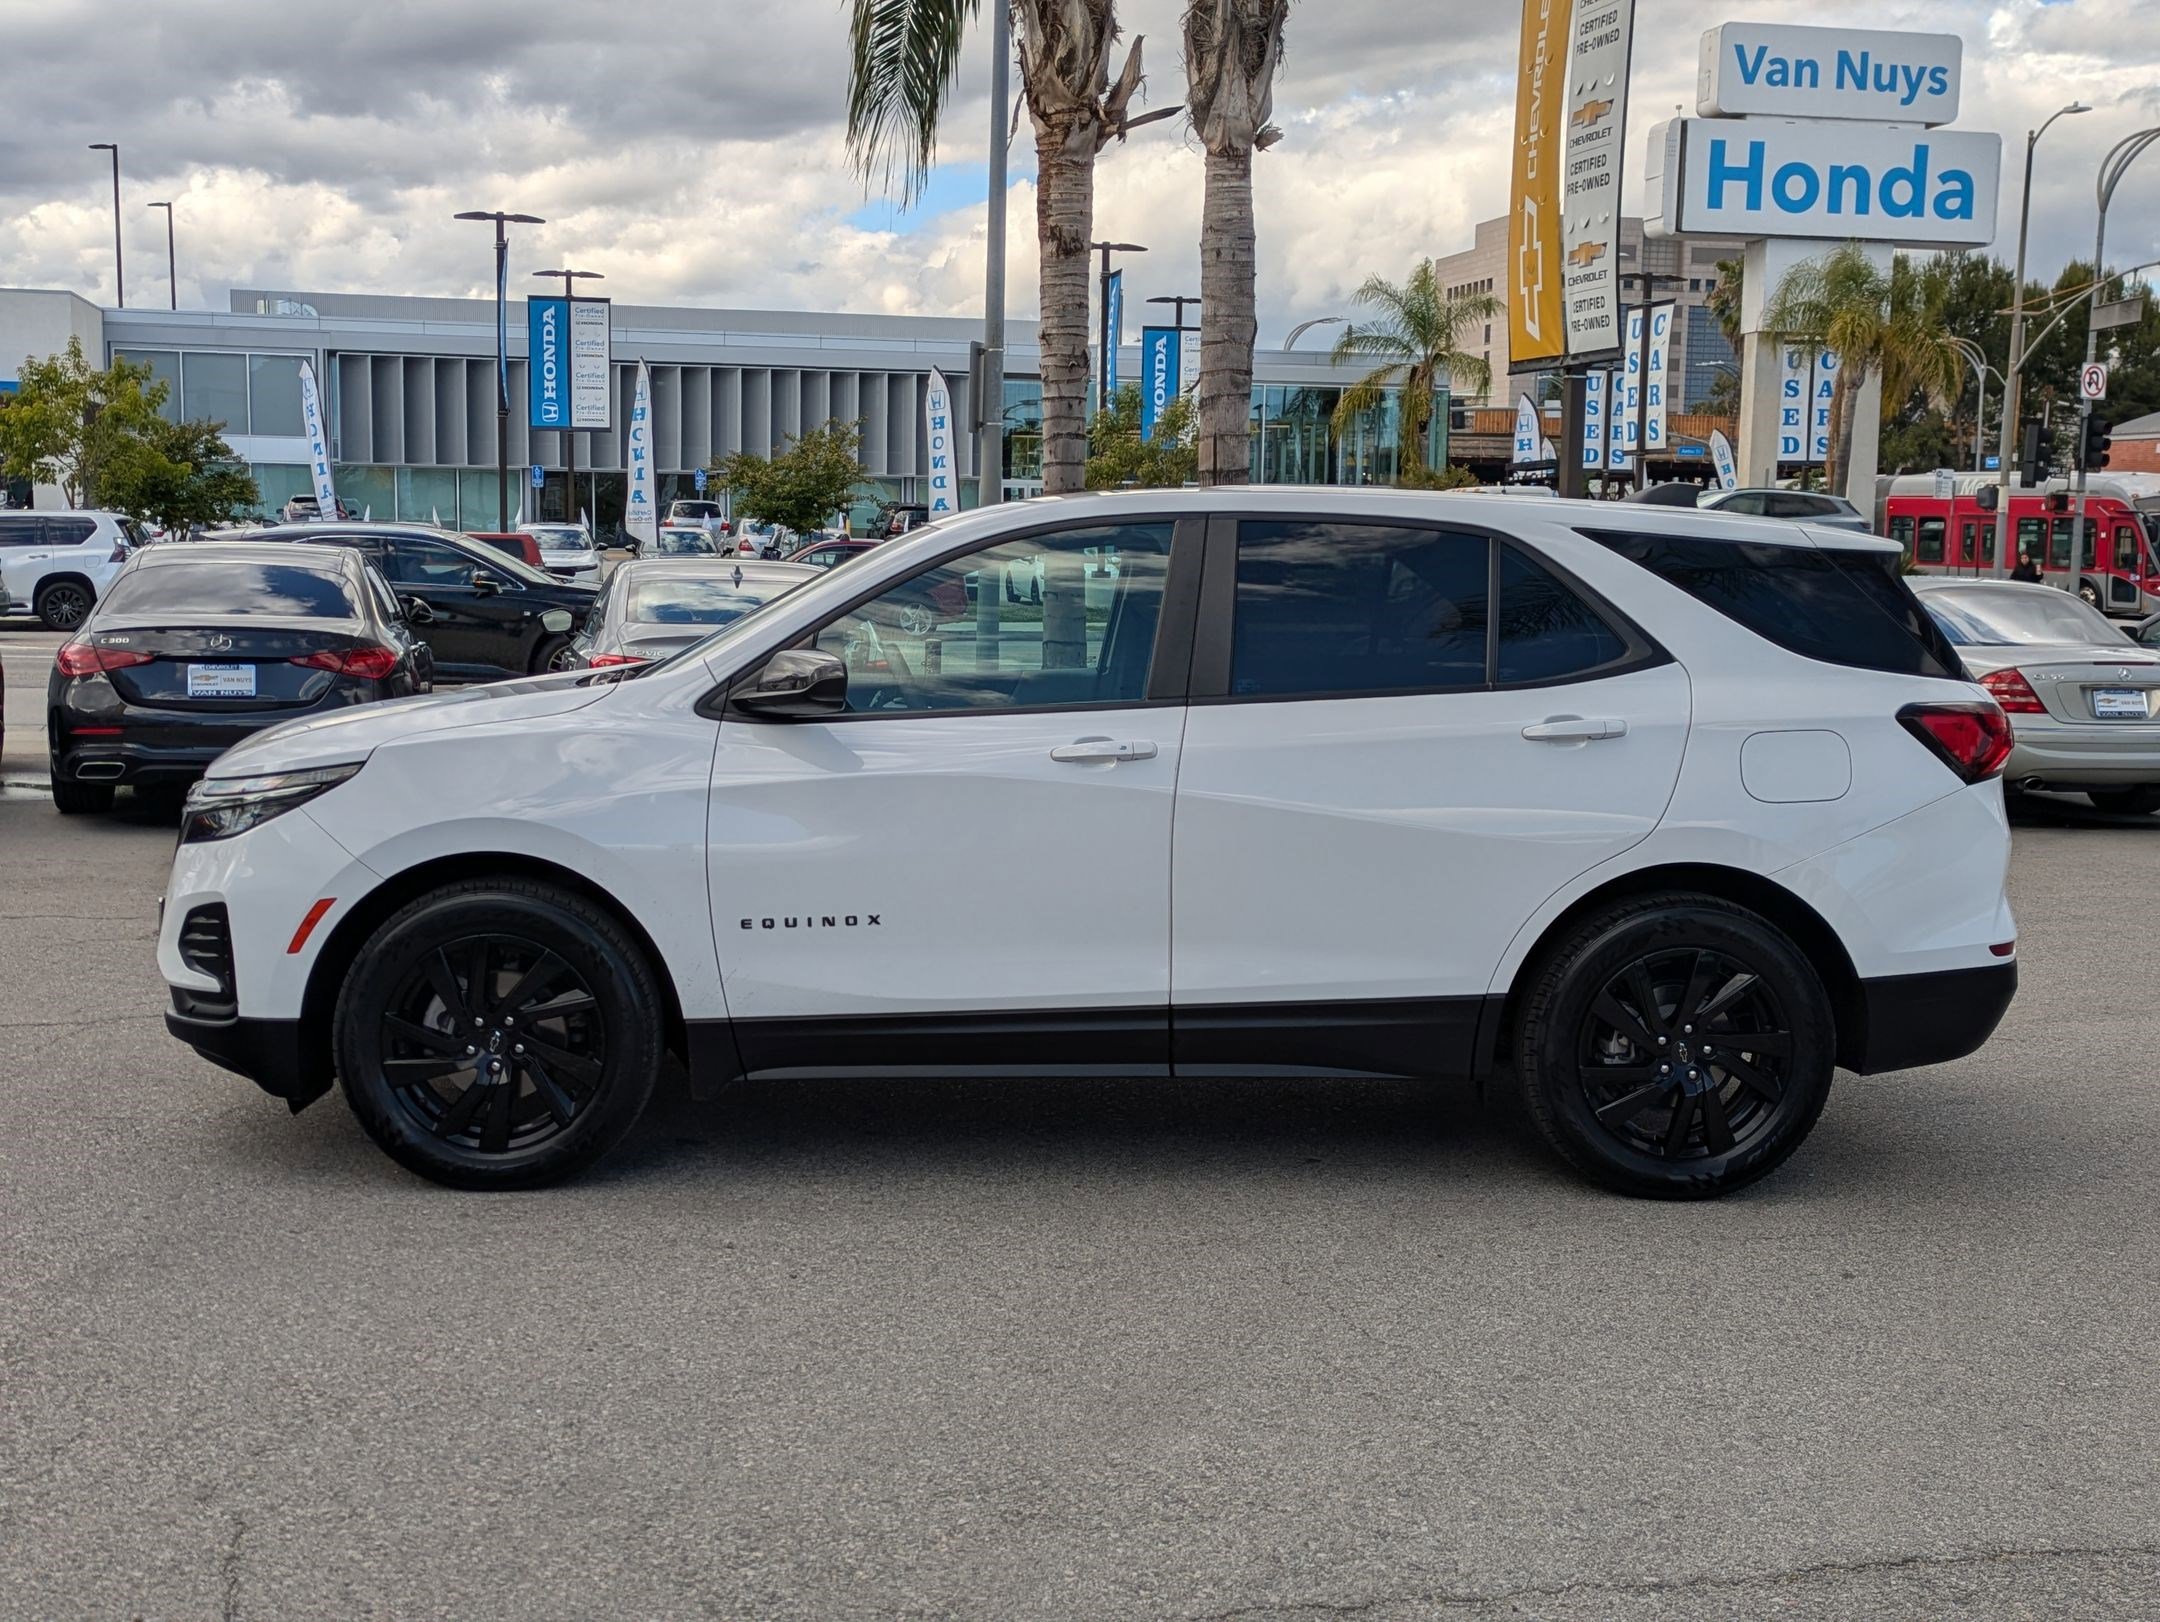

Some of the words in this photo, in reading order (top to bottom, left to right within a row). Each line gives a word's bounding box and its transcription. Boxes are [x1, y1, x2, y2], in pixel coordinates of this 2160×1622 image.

[1576, 28, 1620, 57] PRE-OWNED
[1580, 10, 1617, 36] CERTIFIED
[1734, 43, 1819, 88] Van
[1836, 50, 1949, 106] Nuys
[1569, 127, 1613, 149] CHEVROLET
[1567, 173, 1610, 196] PRE-OWNED
[1570, 154, 1607, 176] CERTIFIED
[1707, 139, 1974, 220] Honda
[1568, 270, 1608, 287] CHEVROLET
[543, 305, 556, 400] HONDA
[1627, 318, 1642, 442] USED
[1648, 313, 1667, 441] CARS
[1583, 376, 1601, 463] USED
[1782, 351, 1803, 454] USED
[740, 914, 881, 929] EQUINOX
